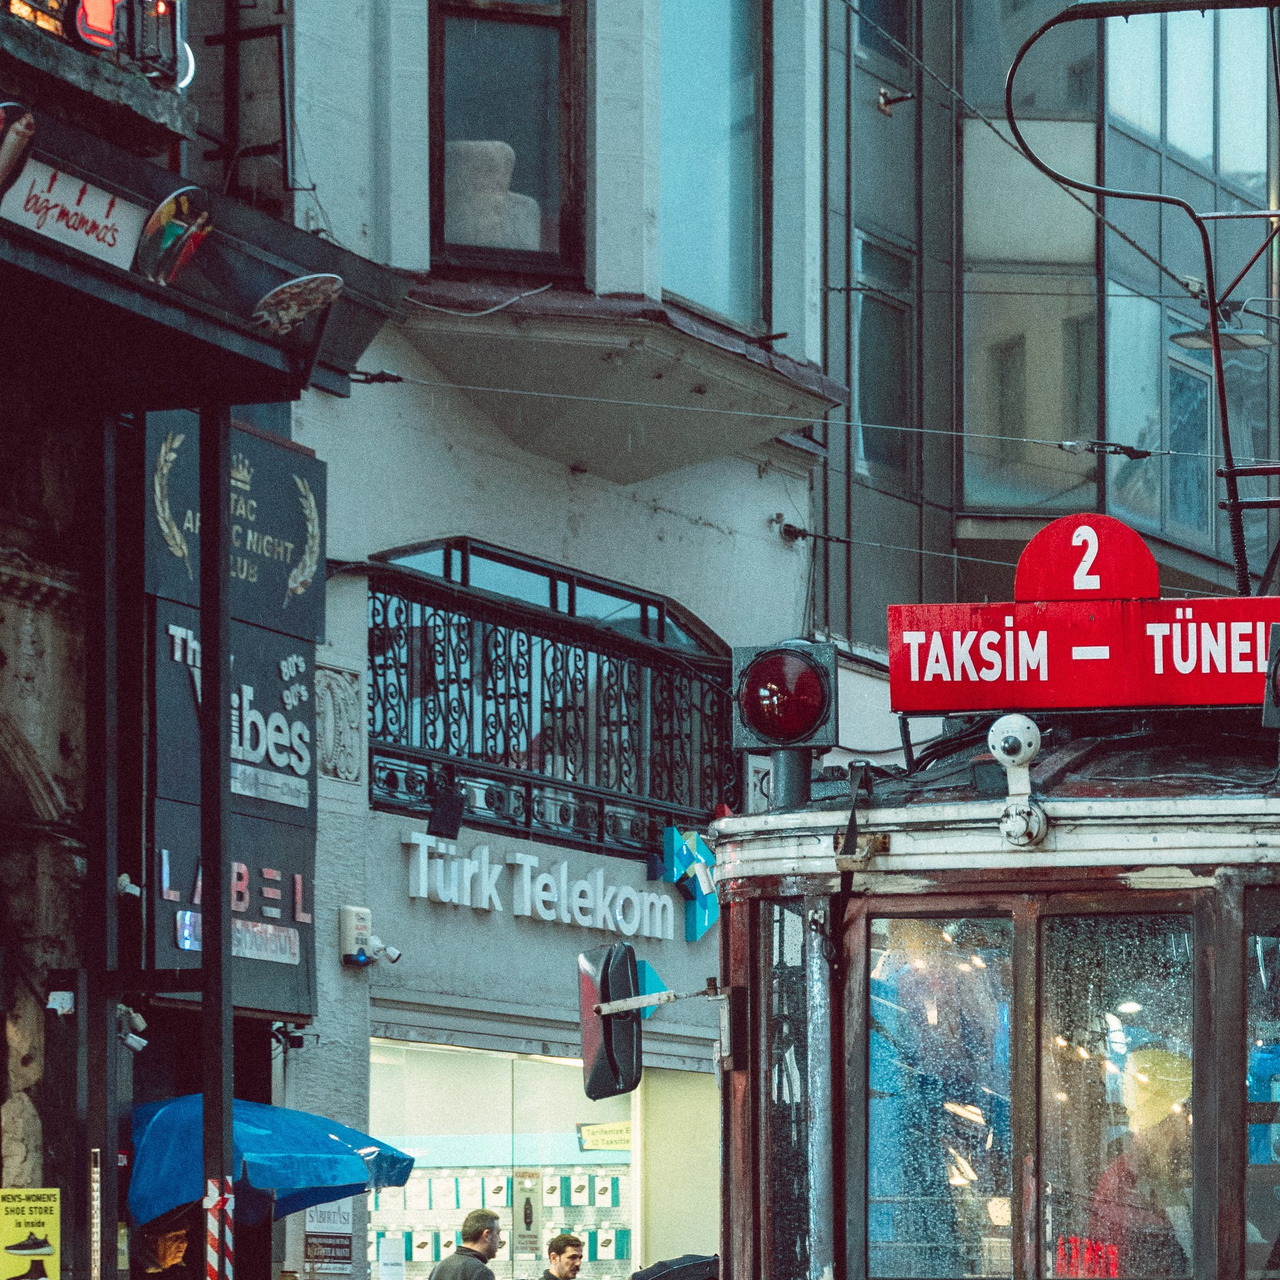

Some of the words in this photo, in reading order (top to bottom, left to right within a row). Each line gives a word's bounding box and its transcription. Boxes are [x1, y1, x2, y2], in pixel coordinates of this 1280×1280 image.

[246, 529, 294, 564] NIGHT
[1071, 526, 1100, 590] 2
[230, 554, 258, 583] LUB
[168, 624, 202, 668] Th
[903, 616, 1048, 681] TAKSİM
[1145, 607, 1271, 675] TÜNEL
[280, 653, 306, 682] 80's
[409, 832, 503, 911] Türk
[506, 852, 674, 940] Telekom
[5, 1206, 26, 1215] SHOE
[29, 1206, 54, 1215] STORE
[15, 1219, 22, 1228] is
[24, 1219, 45, 1228] inside
